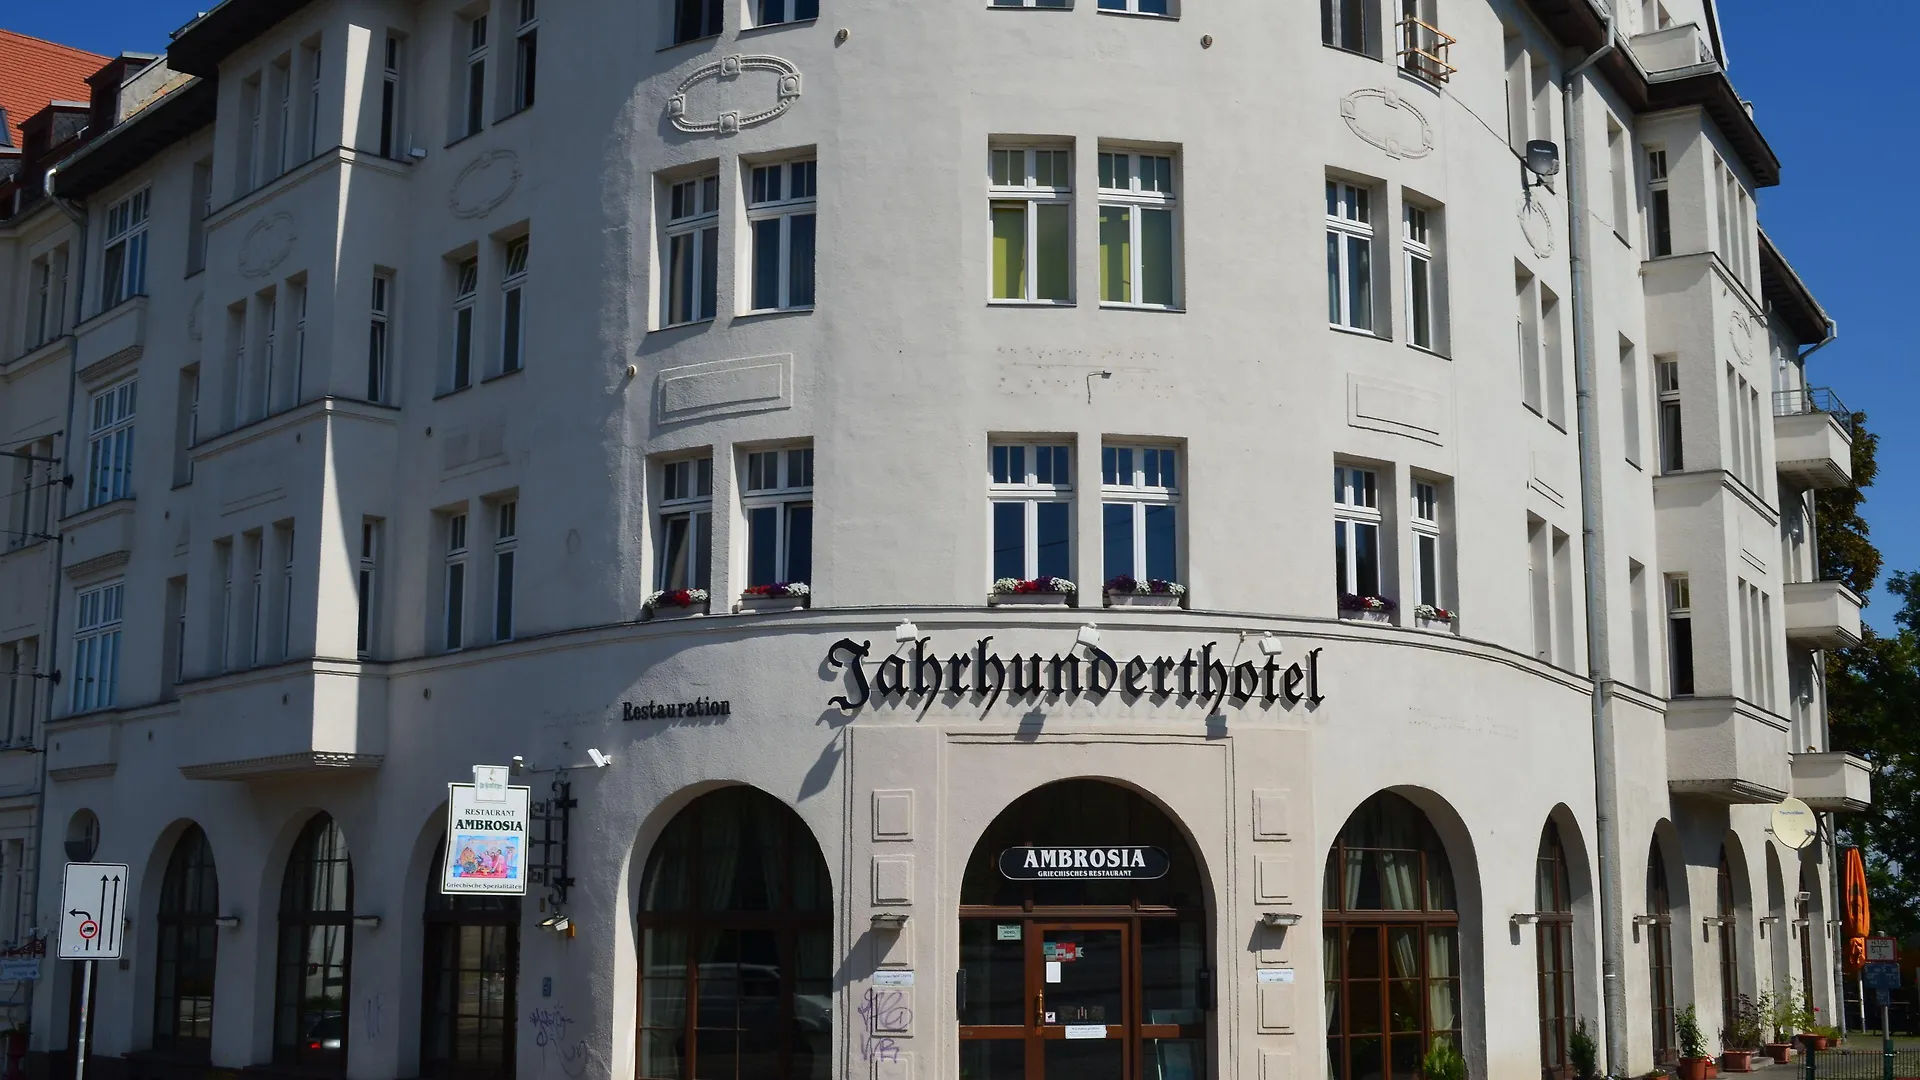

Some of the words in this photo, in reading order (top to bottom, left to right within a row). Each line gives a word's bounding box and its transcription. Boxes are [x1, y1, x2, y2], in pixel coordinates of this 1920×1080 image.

[828, 636, 1325, 722] Jahrhunderthotel
[622, 696, 731, 721] Restauration
[465, 808, 516, 817] RESTAURANT
[455, 819, 523, 831] AMBROSIA
[1023, 849, 1146, 868] AMBROSIA
[446, 882, 482, 890] Griechische
[483, 882, 522, 890] Spezialitäten
